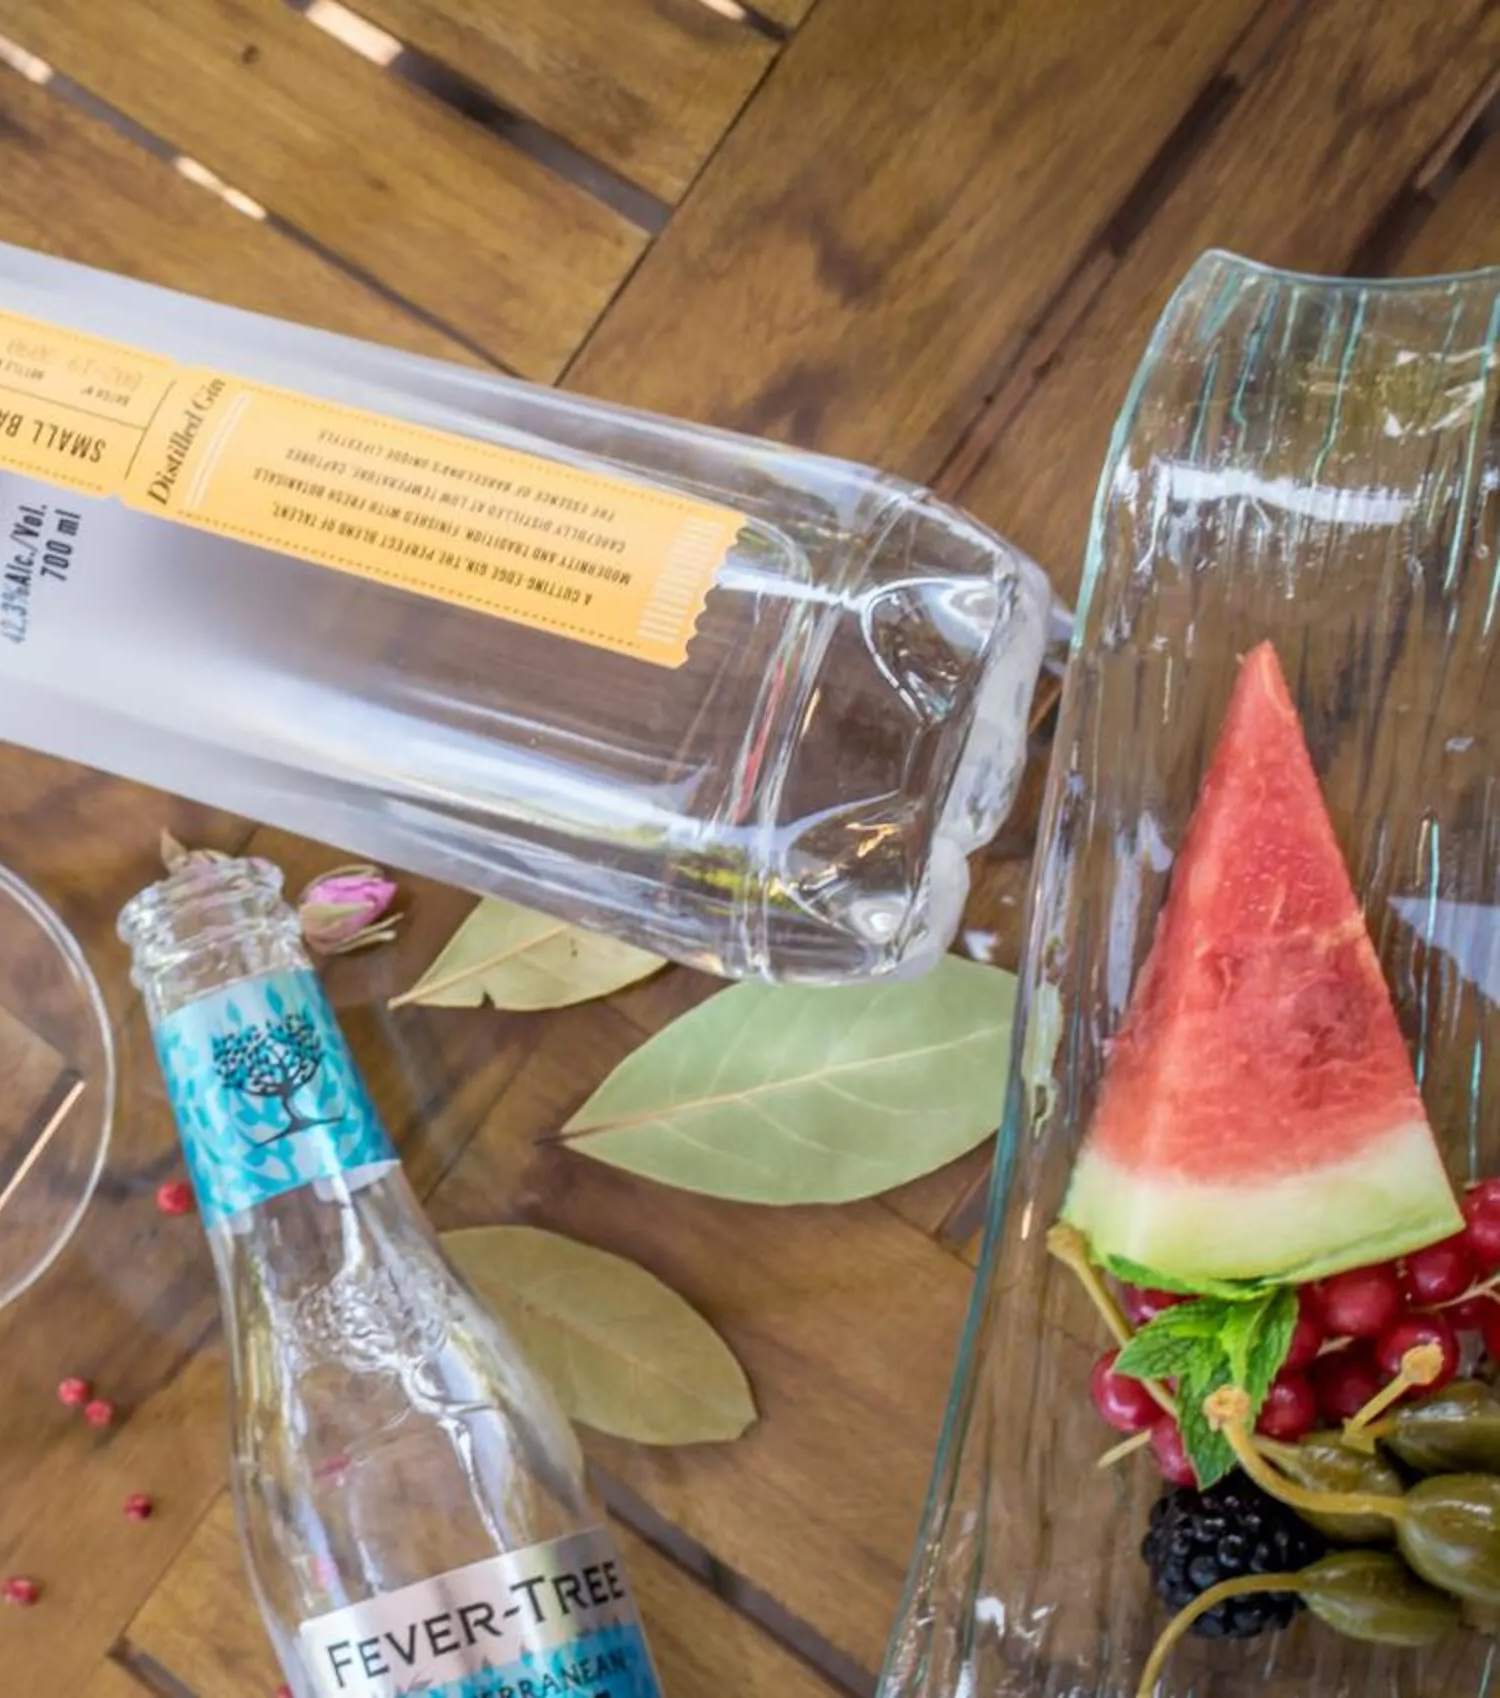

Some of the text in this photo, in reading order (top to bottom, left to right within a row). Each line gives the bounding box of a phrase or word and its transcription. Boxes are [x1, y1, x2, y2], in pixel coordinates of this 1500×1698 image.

[28, 418, 106, 464] SMALL
[146, 409, 203, 504] Distilled
[39, 508, 81, 580] 700 ml
[531, 546, 556, 564] AND
[326, 1561, 625, 1688] FEVER-TREE
